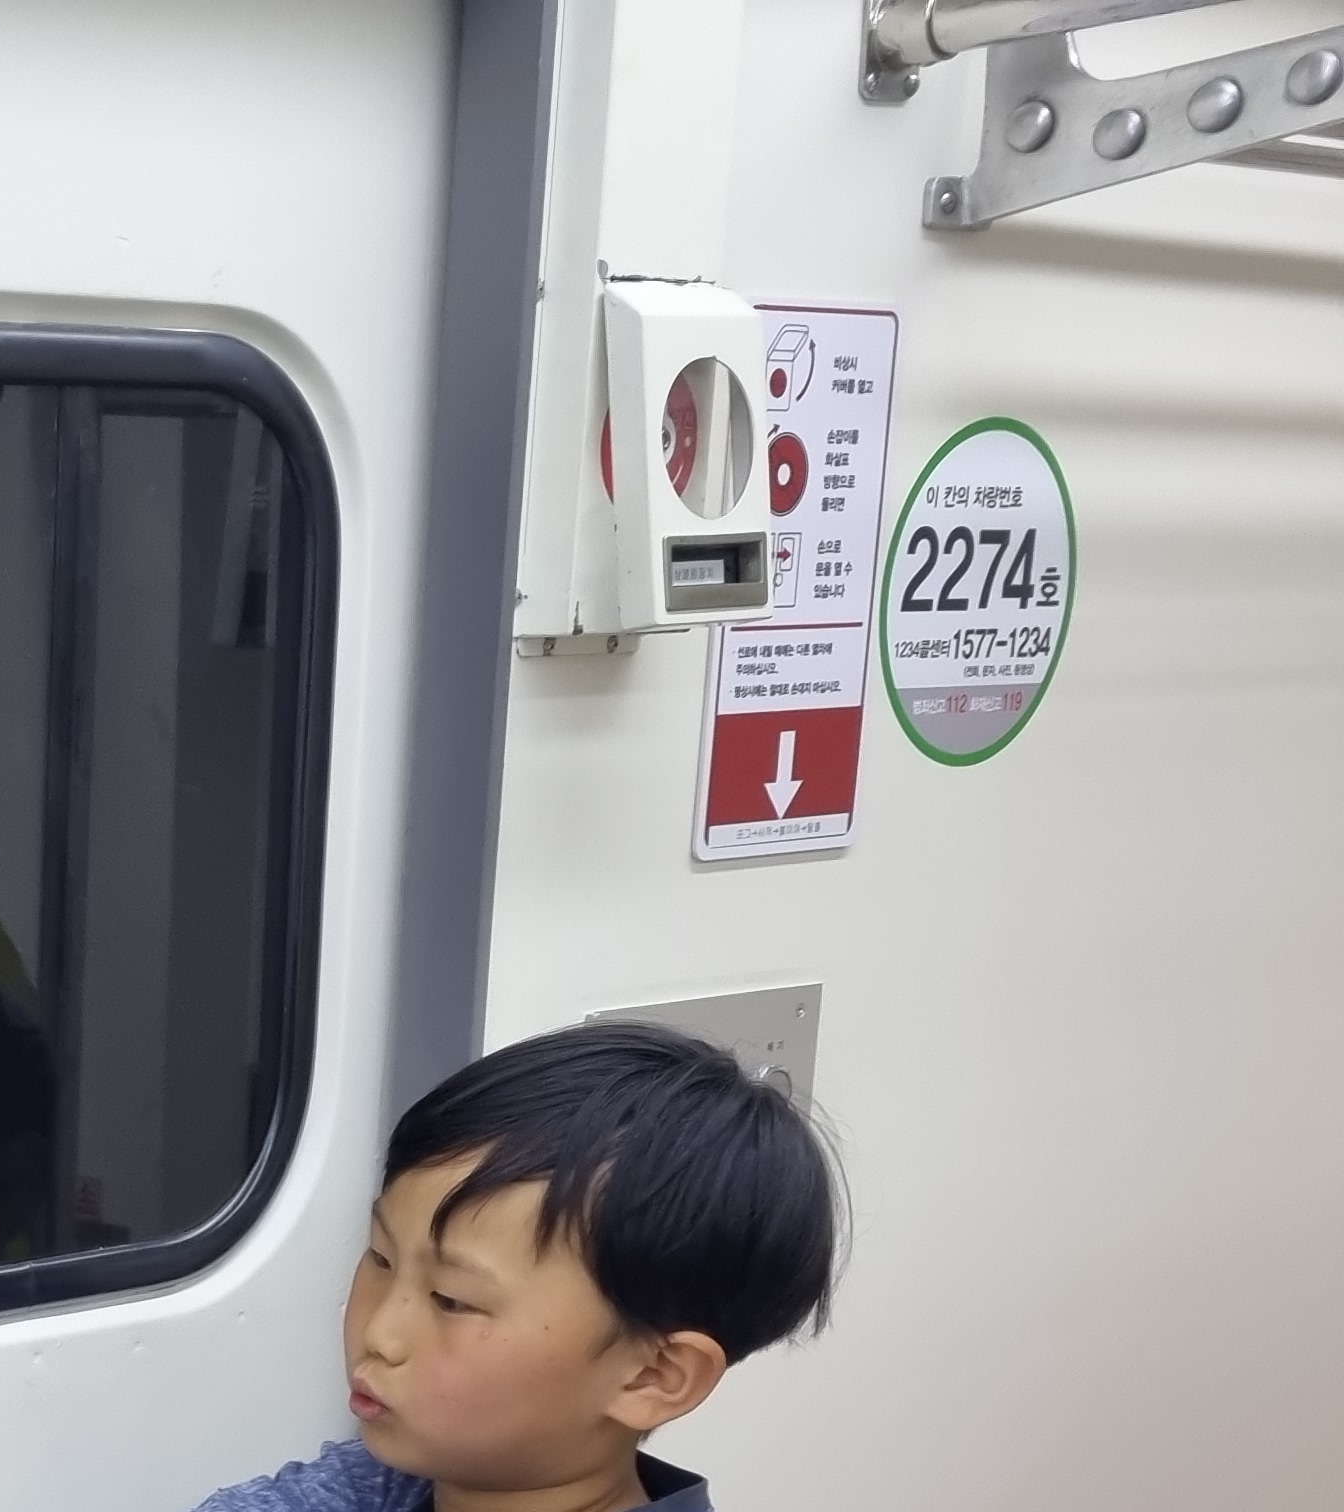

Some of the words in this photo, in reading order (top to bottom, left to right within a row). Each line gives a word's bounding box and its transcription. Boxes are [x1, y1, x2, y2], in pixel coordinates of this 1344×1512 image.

[833, 355, 858, 371] 비상시
[825, 452, 850, 467] 화살표
[823, 474, 856, 489] 방향으로
[926, 485, 939, 508] 이
[943, 485, 970, 508] 칸의
[973, 486, 1023, 508] 차량번호
[817, 540, 842, 554] 손으로
[815, 562, 832, 576] 문을
[844, 561, 853, 576] 수
[813, 584, 845, 598] 있습니다
